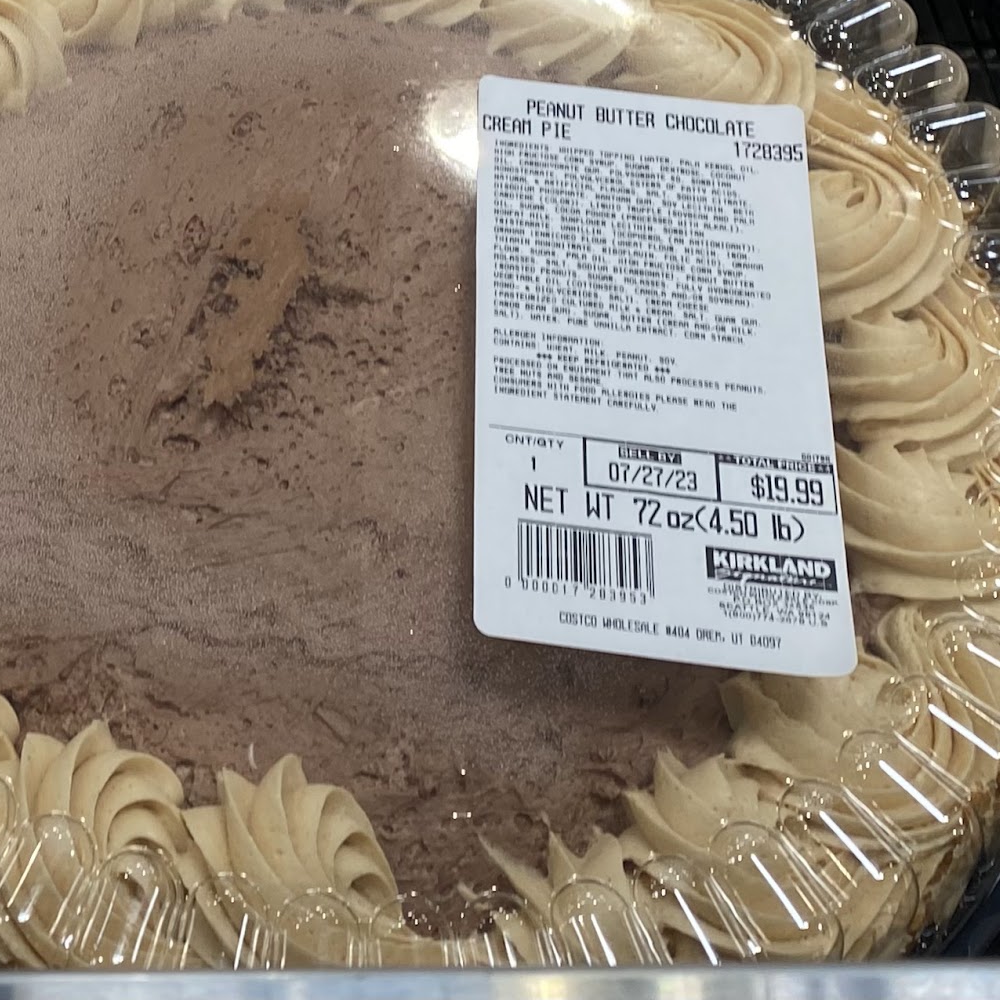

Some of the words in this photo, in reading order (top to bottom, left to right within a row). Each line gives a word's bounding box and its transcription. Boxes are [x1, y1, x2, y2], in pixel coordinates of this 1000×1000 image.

[482, 114, 532, 135] CREAM
[541, 120, 571, 139] PIE
[526, 99, 584, 120] PEANUT
[595, 106, 655, 128] BUTTER
[665, 112, 755, 138] CHOCOLATE
[733, 137, 804, 164] 1728395
[531, 455, 536, 471] 1
[609, 462, 697, 491] 07/27/23
[750, 473, 824, 507] $19.99
[524, 484, 568, 515] NET
[586, 491, 614, 521] WT
[771, 513, 806, 543] lb)
[713, 549, 831, 579] KIRKLAND
[559, 612, 596, 628] COSTCO
[602, 617, 658, 635] WHOLESALE
[731, 632, 743, 645] UT
